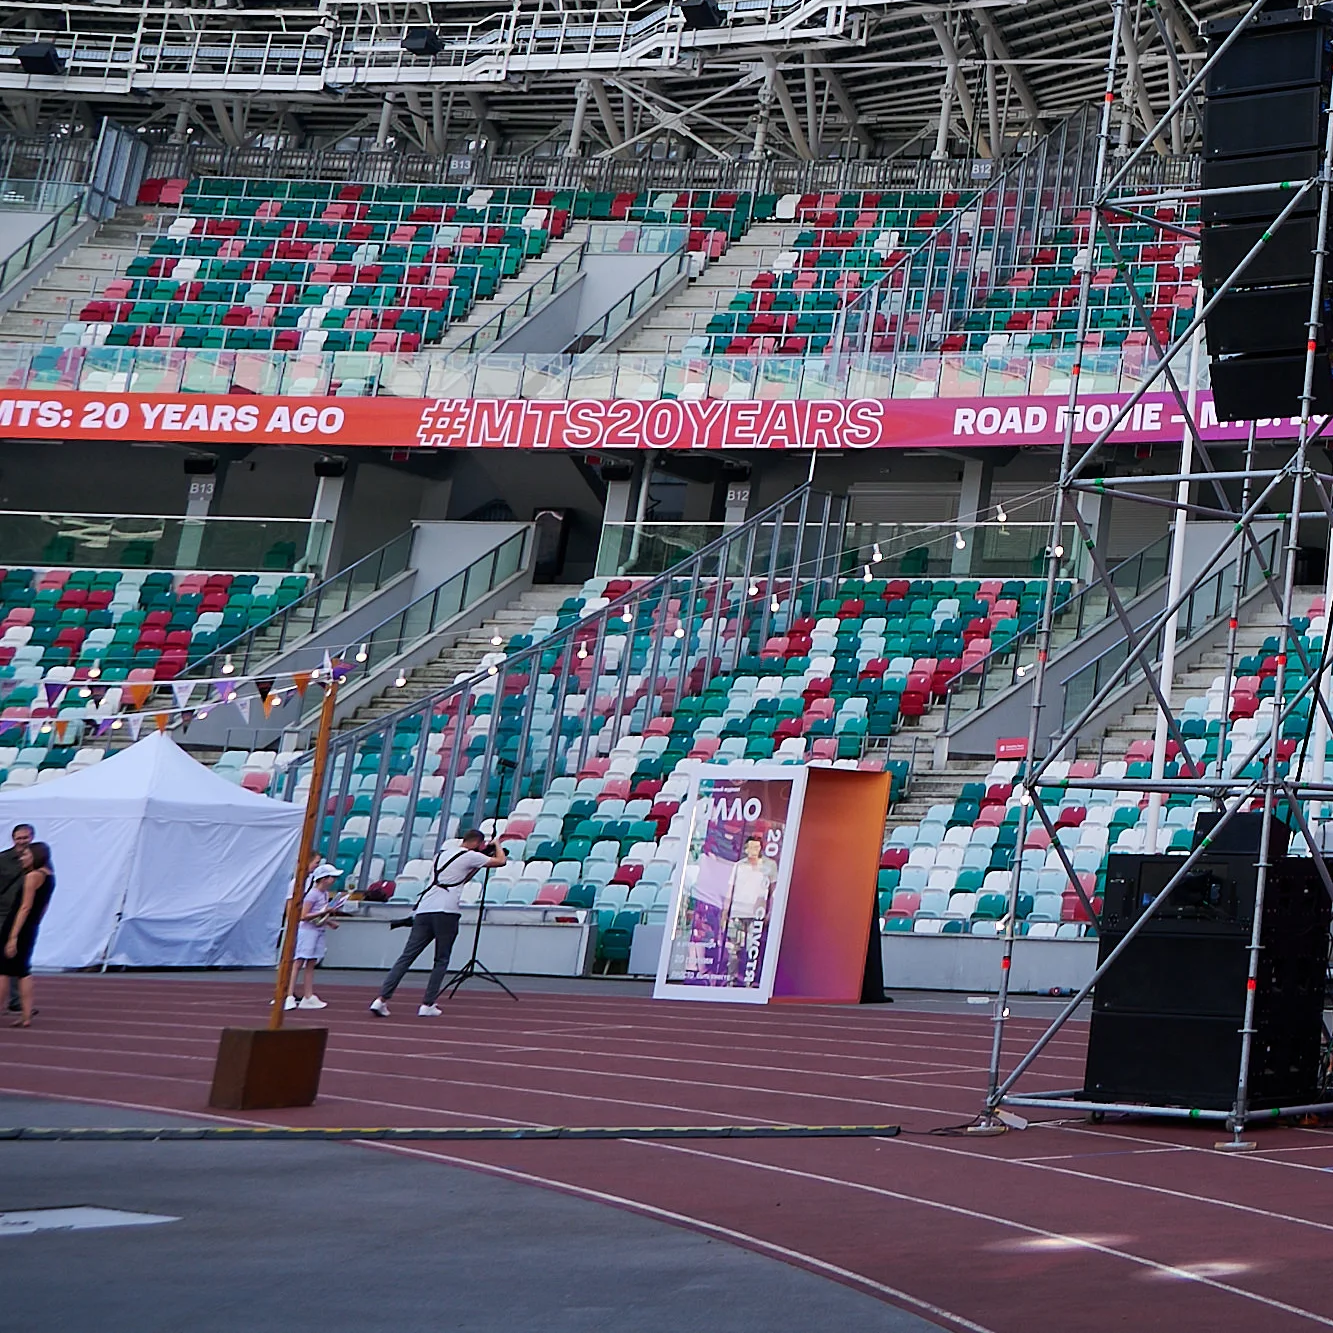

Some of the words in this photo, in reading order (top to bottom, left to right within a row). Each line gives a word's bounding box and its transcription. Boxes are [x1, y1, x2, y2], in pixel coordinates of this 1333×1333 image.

[450, 160, 471, 170] B13
[972, 164, 991, 174] B12
[81, 402, 129, 429] 20
[140, 404, 259, 433] YEARS
[264, 406, 345, 434] AGO
[416, 398, 884, 448] #MTS20YEARS
[953, 406, 1047, 435] ROAD
[1055, 403, 1163, 433] MOVIE
[190, 483, 213, 494] B13
[727, 490, 748, 501] B12
